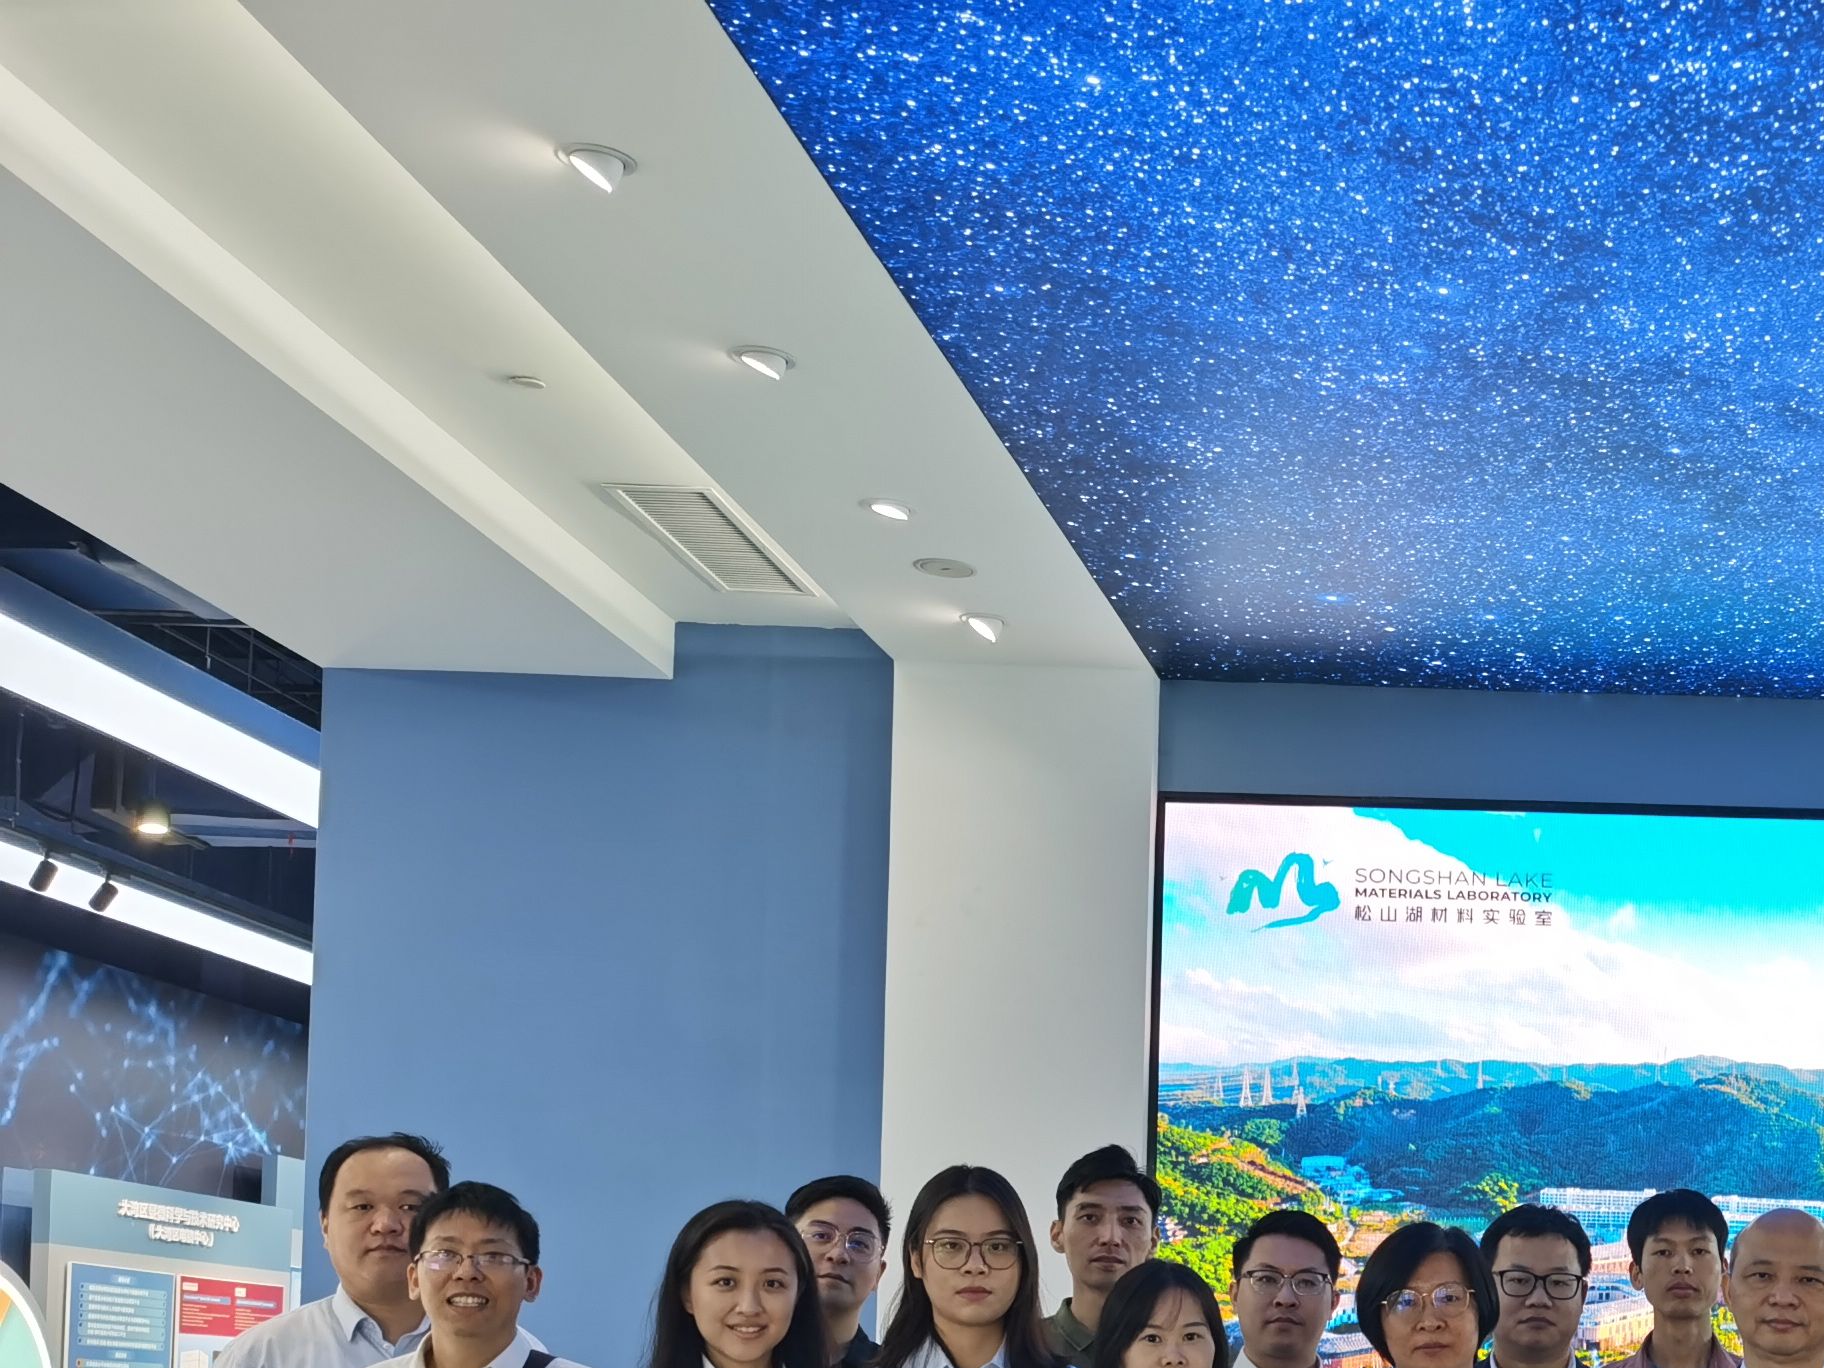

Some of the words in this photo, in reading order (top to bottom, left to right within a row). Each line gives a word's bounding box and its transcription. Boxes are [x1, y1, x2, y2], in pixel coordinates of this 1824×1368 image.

[1354, 867, 1487, 886] SONGSHAN
[1496, 872, 1553, 888] LAKE
[1354, 887, 1442, 900] MATERIALS
[1447, 889, 1553, 903] LABORATORY
[1353, 904, 1553, 927] 松山湖材料实验室
